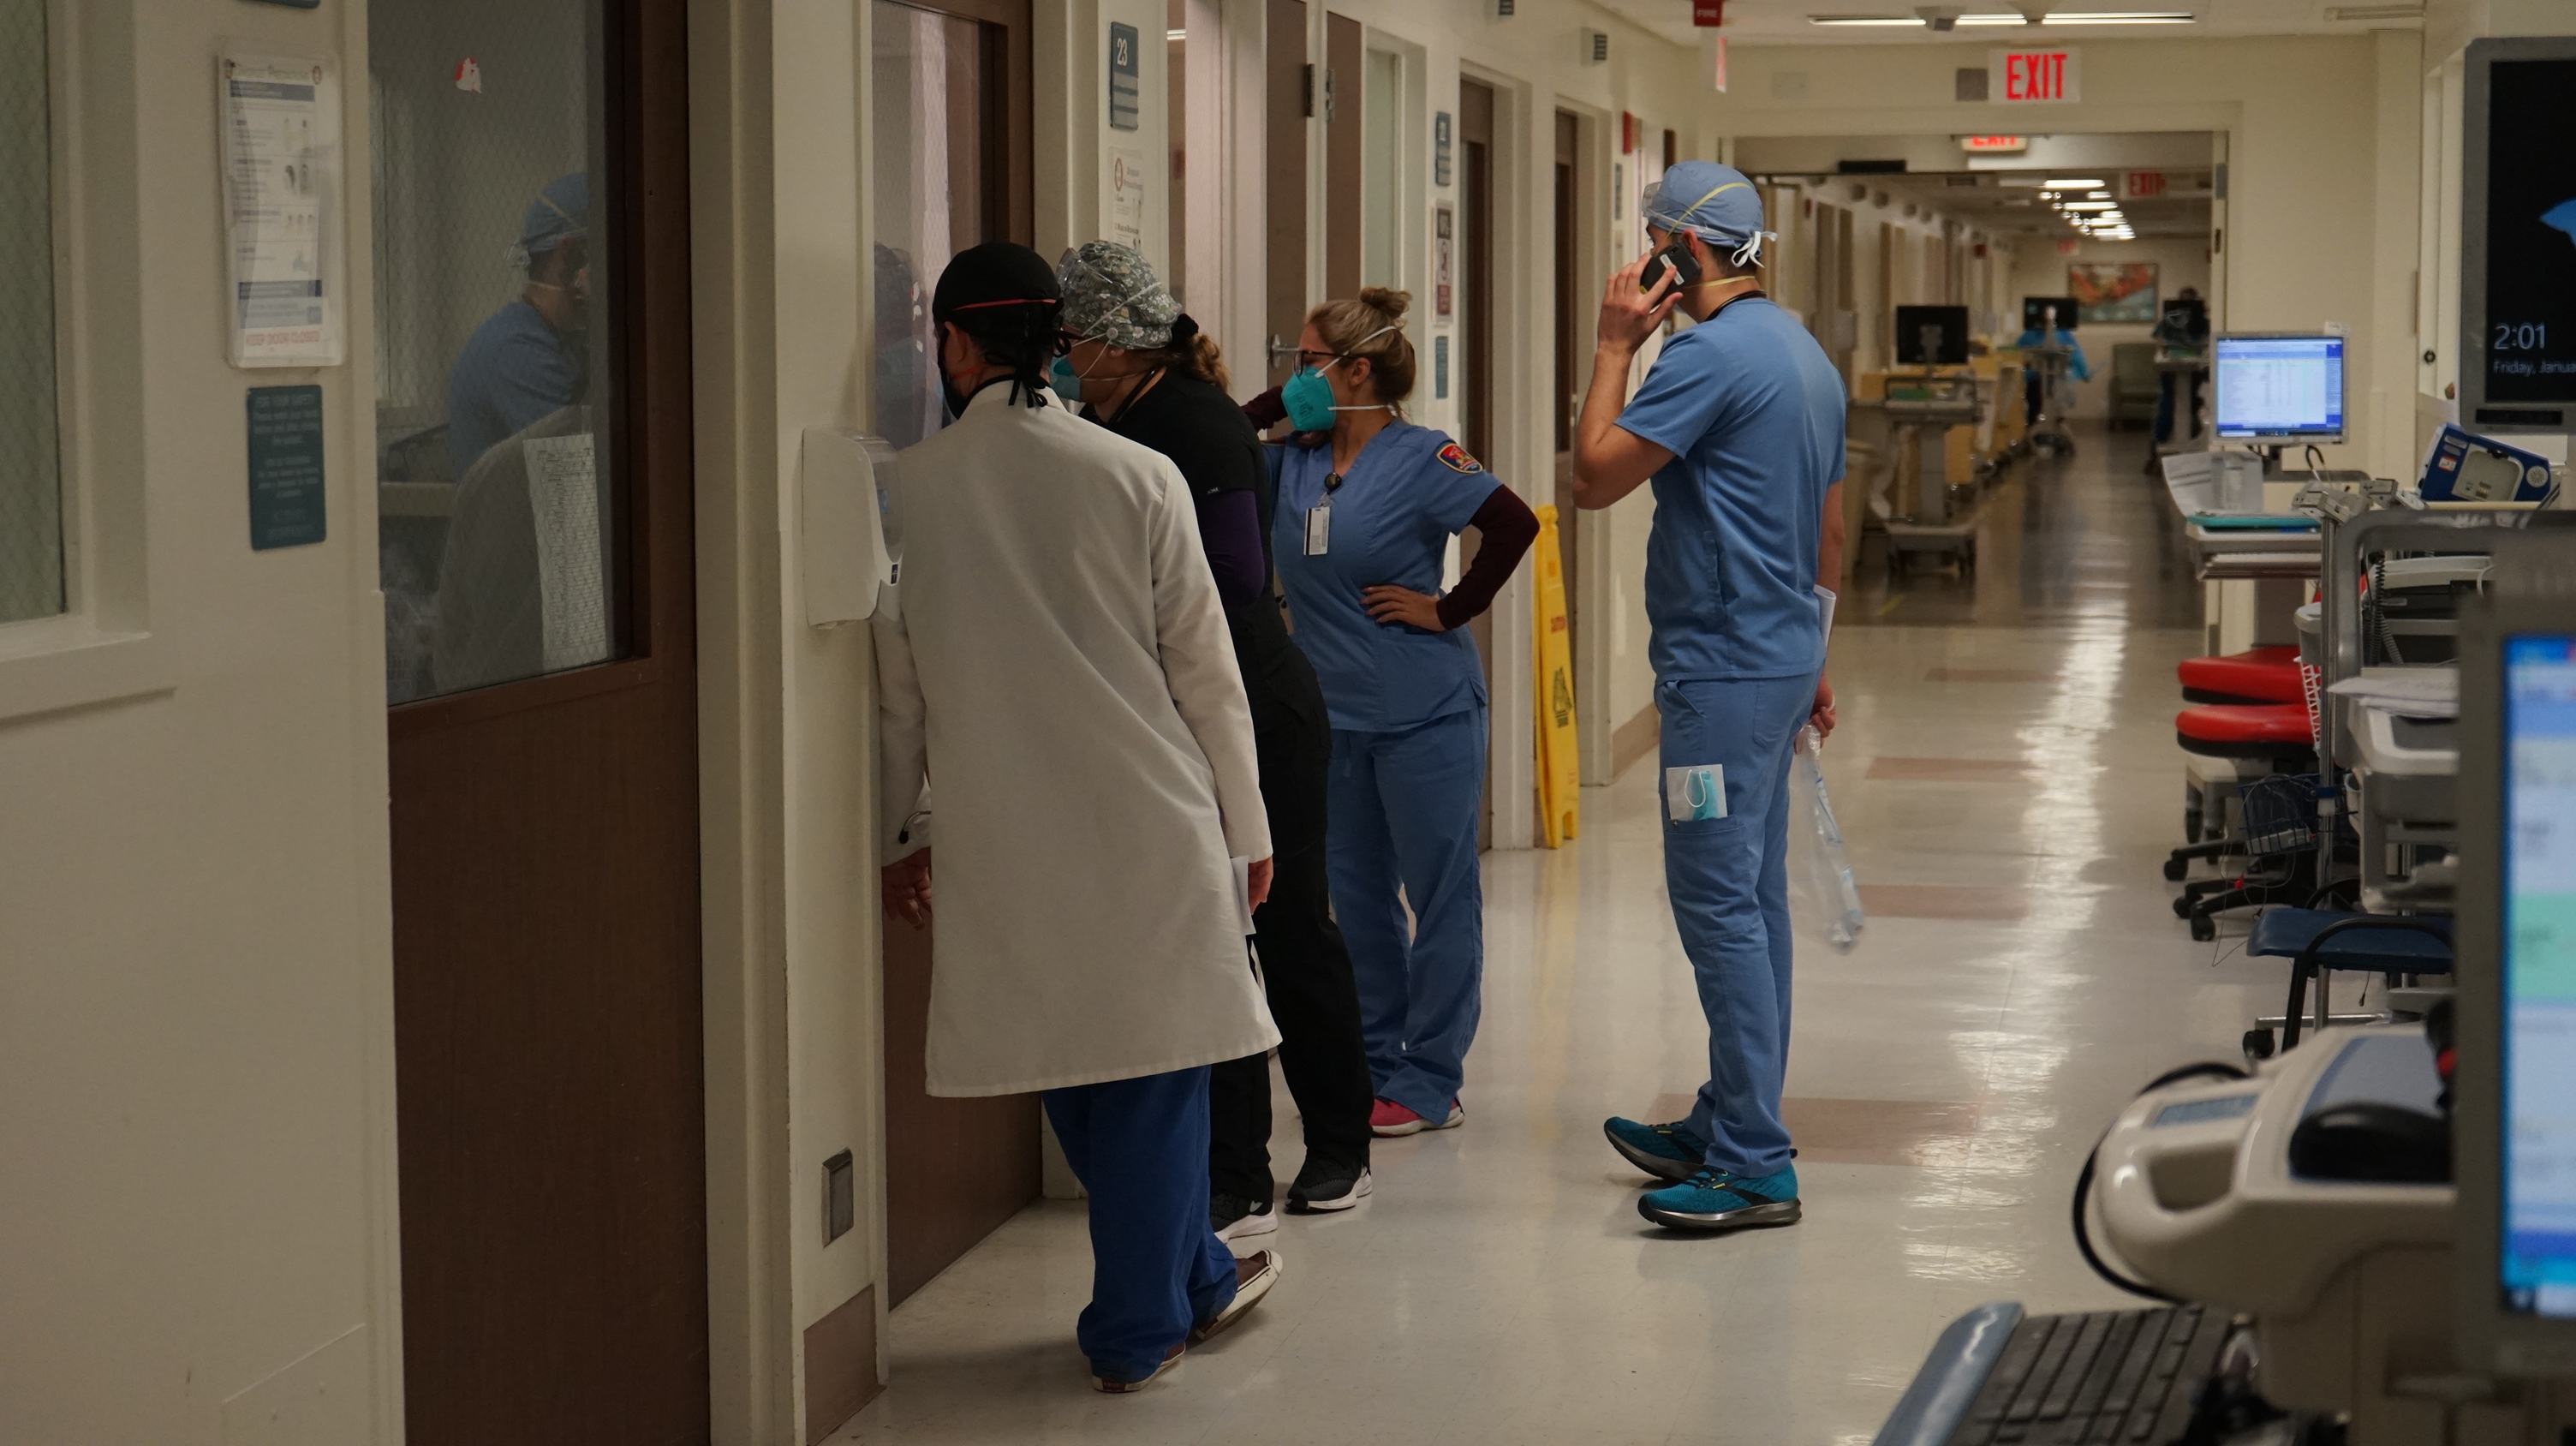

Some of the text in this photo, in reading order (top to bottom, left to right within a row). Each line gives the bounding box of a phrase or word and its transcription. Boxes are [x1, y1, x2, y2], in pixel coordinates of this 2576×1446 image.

[1117, 37, 1127, 67] 23
[2007, 54, 2067, 99] EXIT
[2494, 322, 2545, 350] 2:01
[2493, 360, 2537, 377] Friday,
